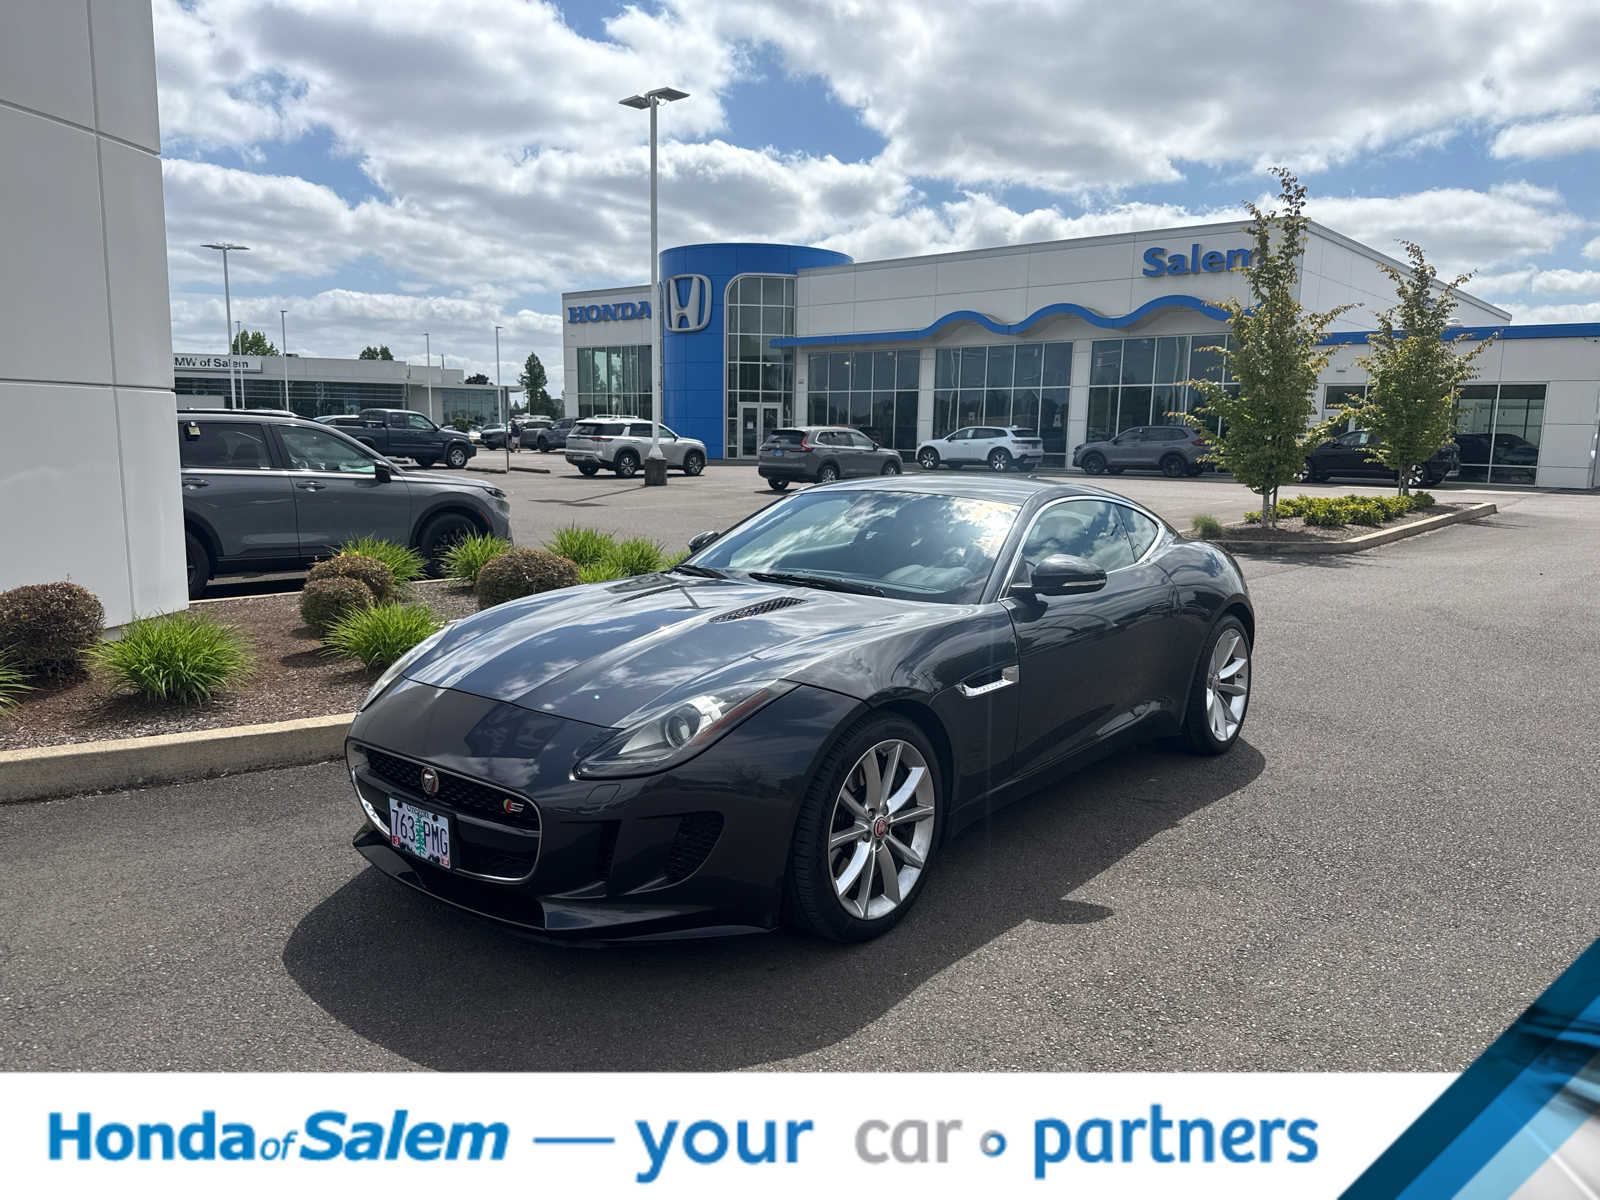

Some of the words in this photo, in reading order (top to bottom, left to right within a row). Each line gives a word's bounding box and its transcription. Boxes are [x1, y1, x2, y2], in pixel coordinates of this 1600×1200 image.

[568, 301, 652, 323] HONDA
[174, 357, 197, 366] MW
[200, 358, 211, 367] of
[213, 359, 248, 368] Salem
[391, 809, 416, 842] 763
[423, 820, 448, 855] PMG
